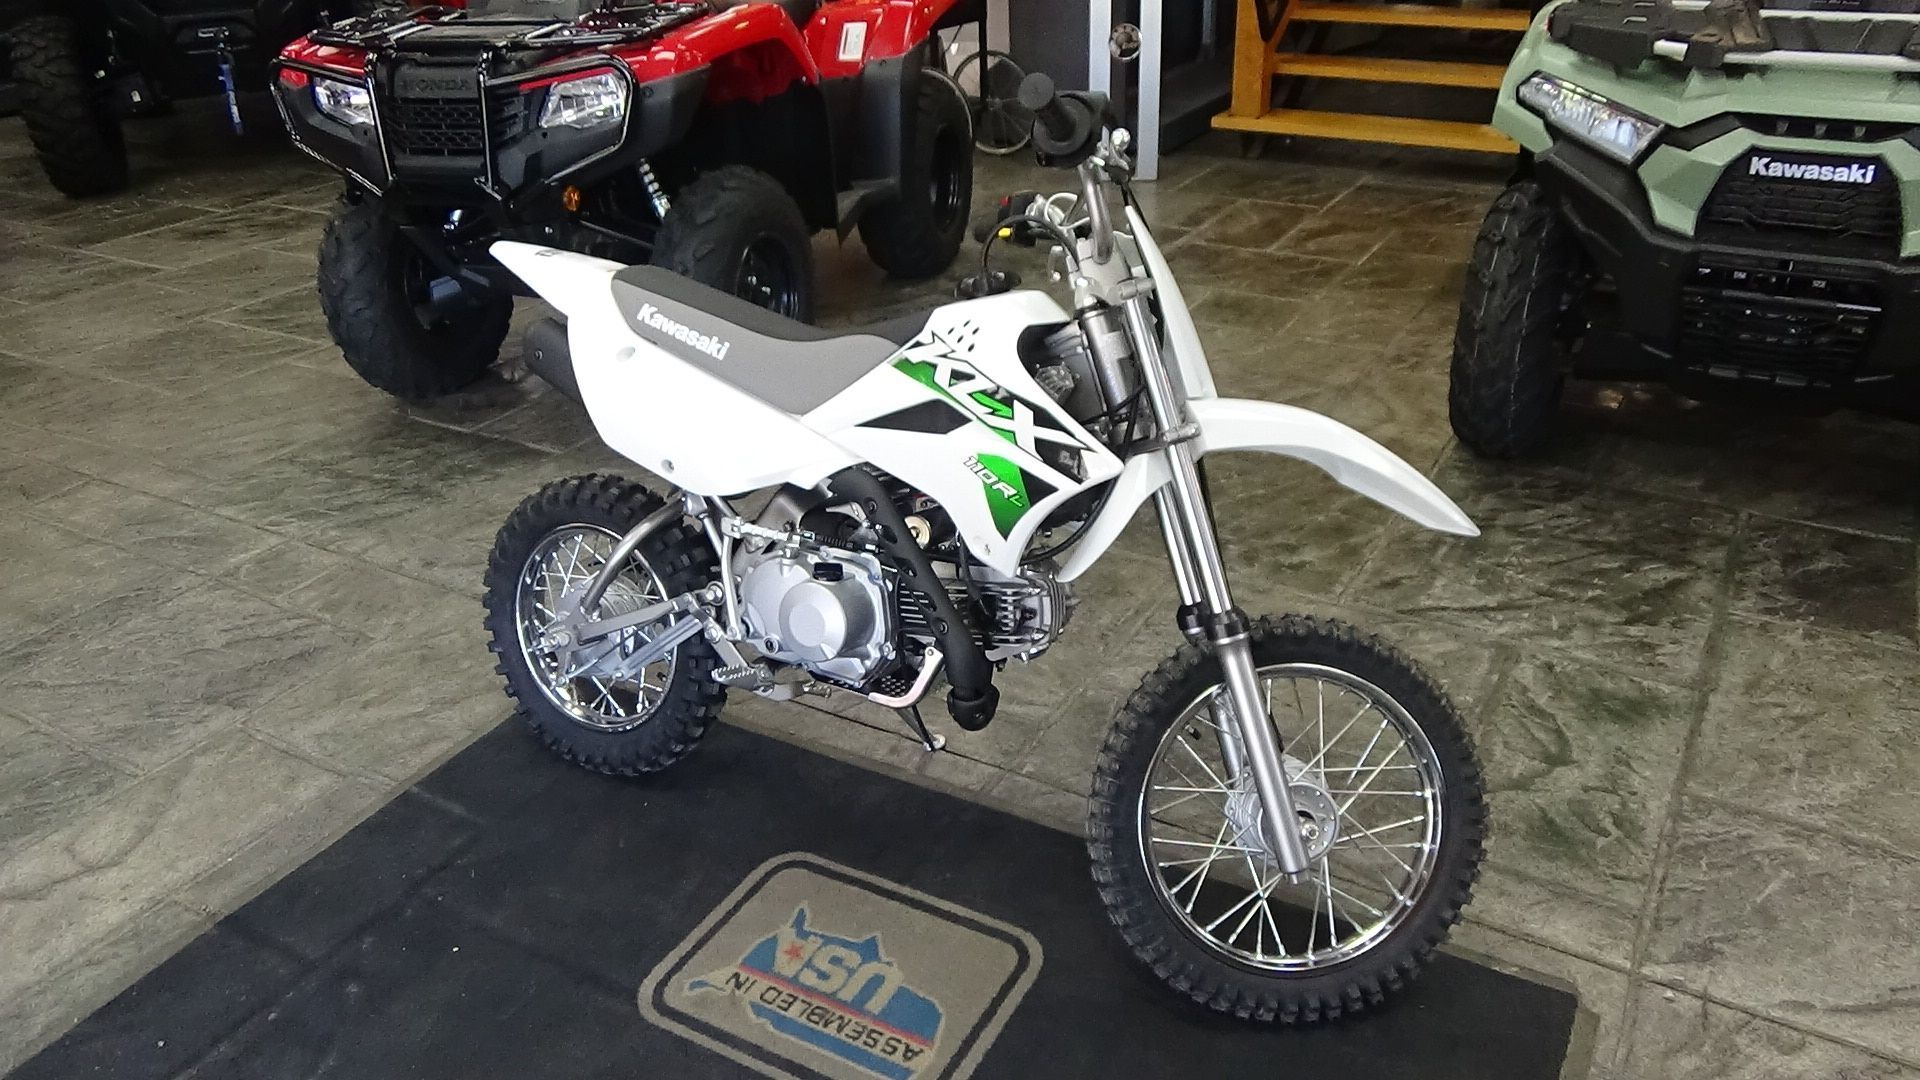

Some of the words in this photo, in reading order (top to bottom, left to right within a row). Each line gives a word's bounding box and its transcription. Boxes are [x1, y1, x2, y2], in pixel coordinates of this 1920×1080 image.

[1748, 156, 1876, 184] Kawasaki
[636, 303, 730, 361] Kawasaki
[902, 331, 1098, 461] KLX
[725, 971, 759, 996] IN
[772, 926, 905, 1015] USA
[760, 985, 925, 1064] ASSEMBLED
